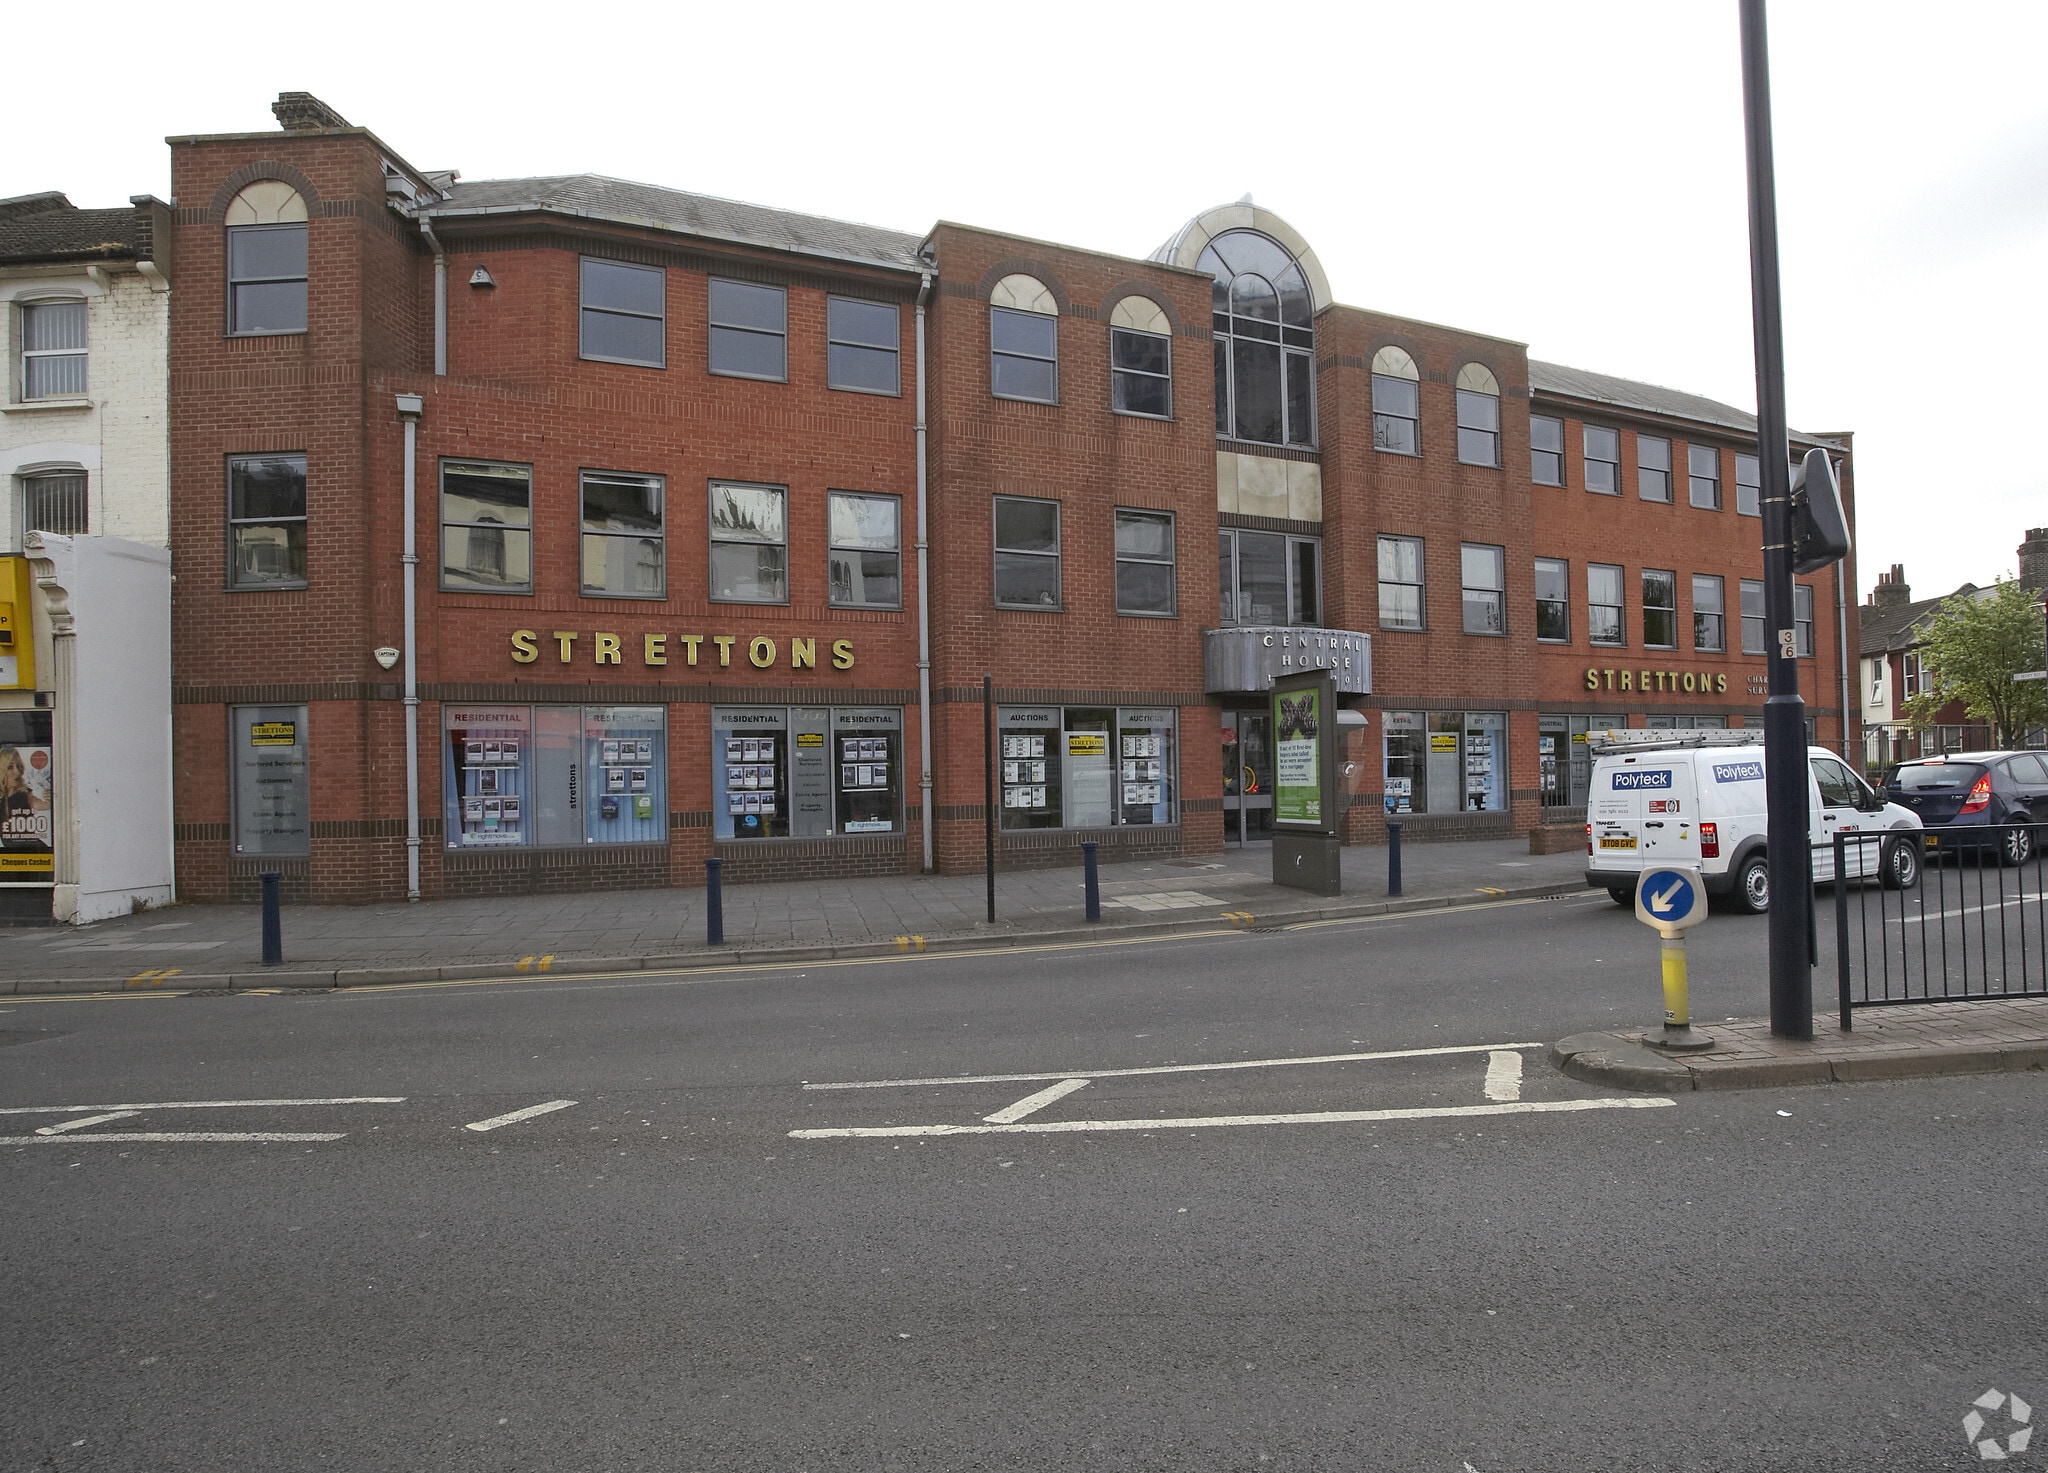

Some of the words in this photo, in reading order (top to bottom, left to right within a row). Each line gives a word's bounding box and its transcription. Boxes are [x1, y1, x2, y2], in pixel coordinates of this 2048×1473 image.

[1263, 635, 1360, 651] CENTRAL
[1784, 632, 1792, 643] 3
[511, 630, 855, 670] STRETTONS
[1786, 646, 1794, 657] 6
[1282, 655, 1350, 668] HOUSE
[1587, 668, 1727, 693] STRETTONS
[1747, 675, 1768, 684] CHAR
[1747, 686, 1768, 695] SURV
[455, 714, 522, 722] RESIDENTIAL
[594, 714, 656, 722] RESIDENTIAL
[722, 715, 779, 723] RESIDENTIAL
[1716, 763, 1760, 780] Polyteck
[1615, 772, 1667, 788] Polyteck
[569, 763, 577, 809] strettons
[2, 815, 47, 833] £1000
[1602, 839, 1619, 848] BT08
[1620, 839, 1634, 848] GVC
[1926, 836, 1936, 844] VE
[2, 858, 28, 866] Cheques
[28, 858, 51, 866] Cashed
